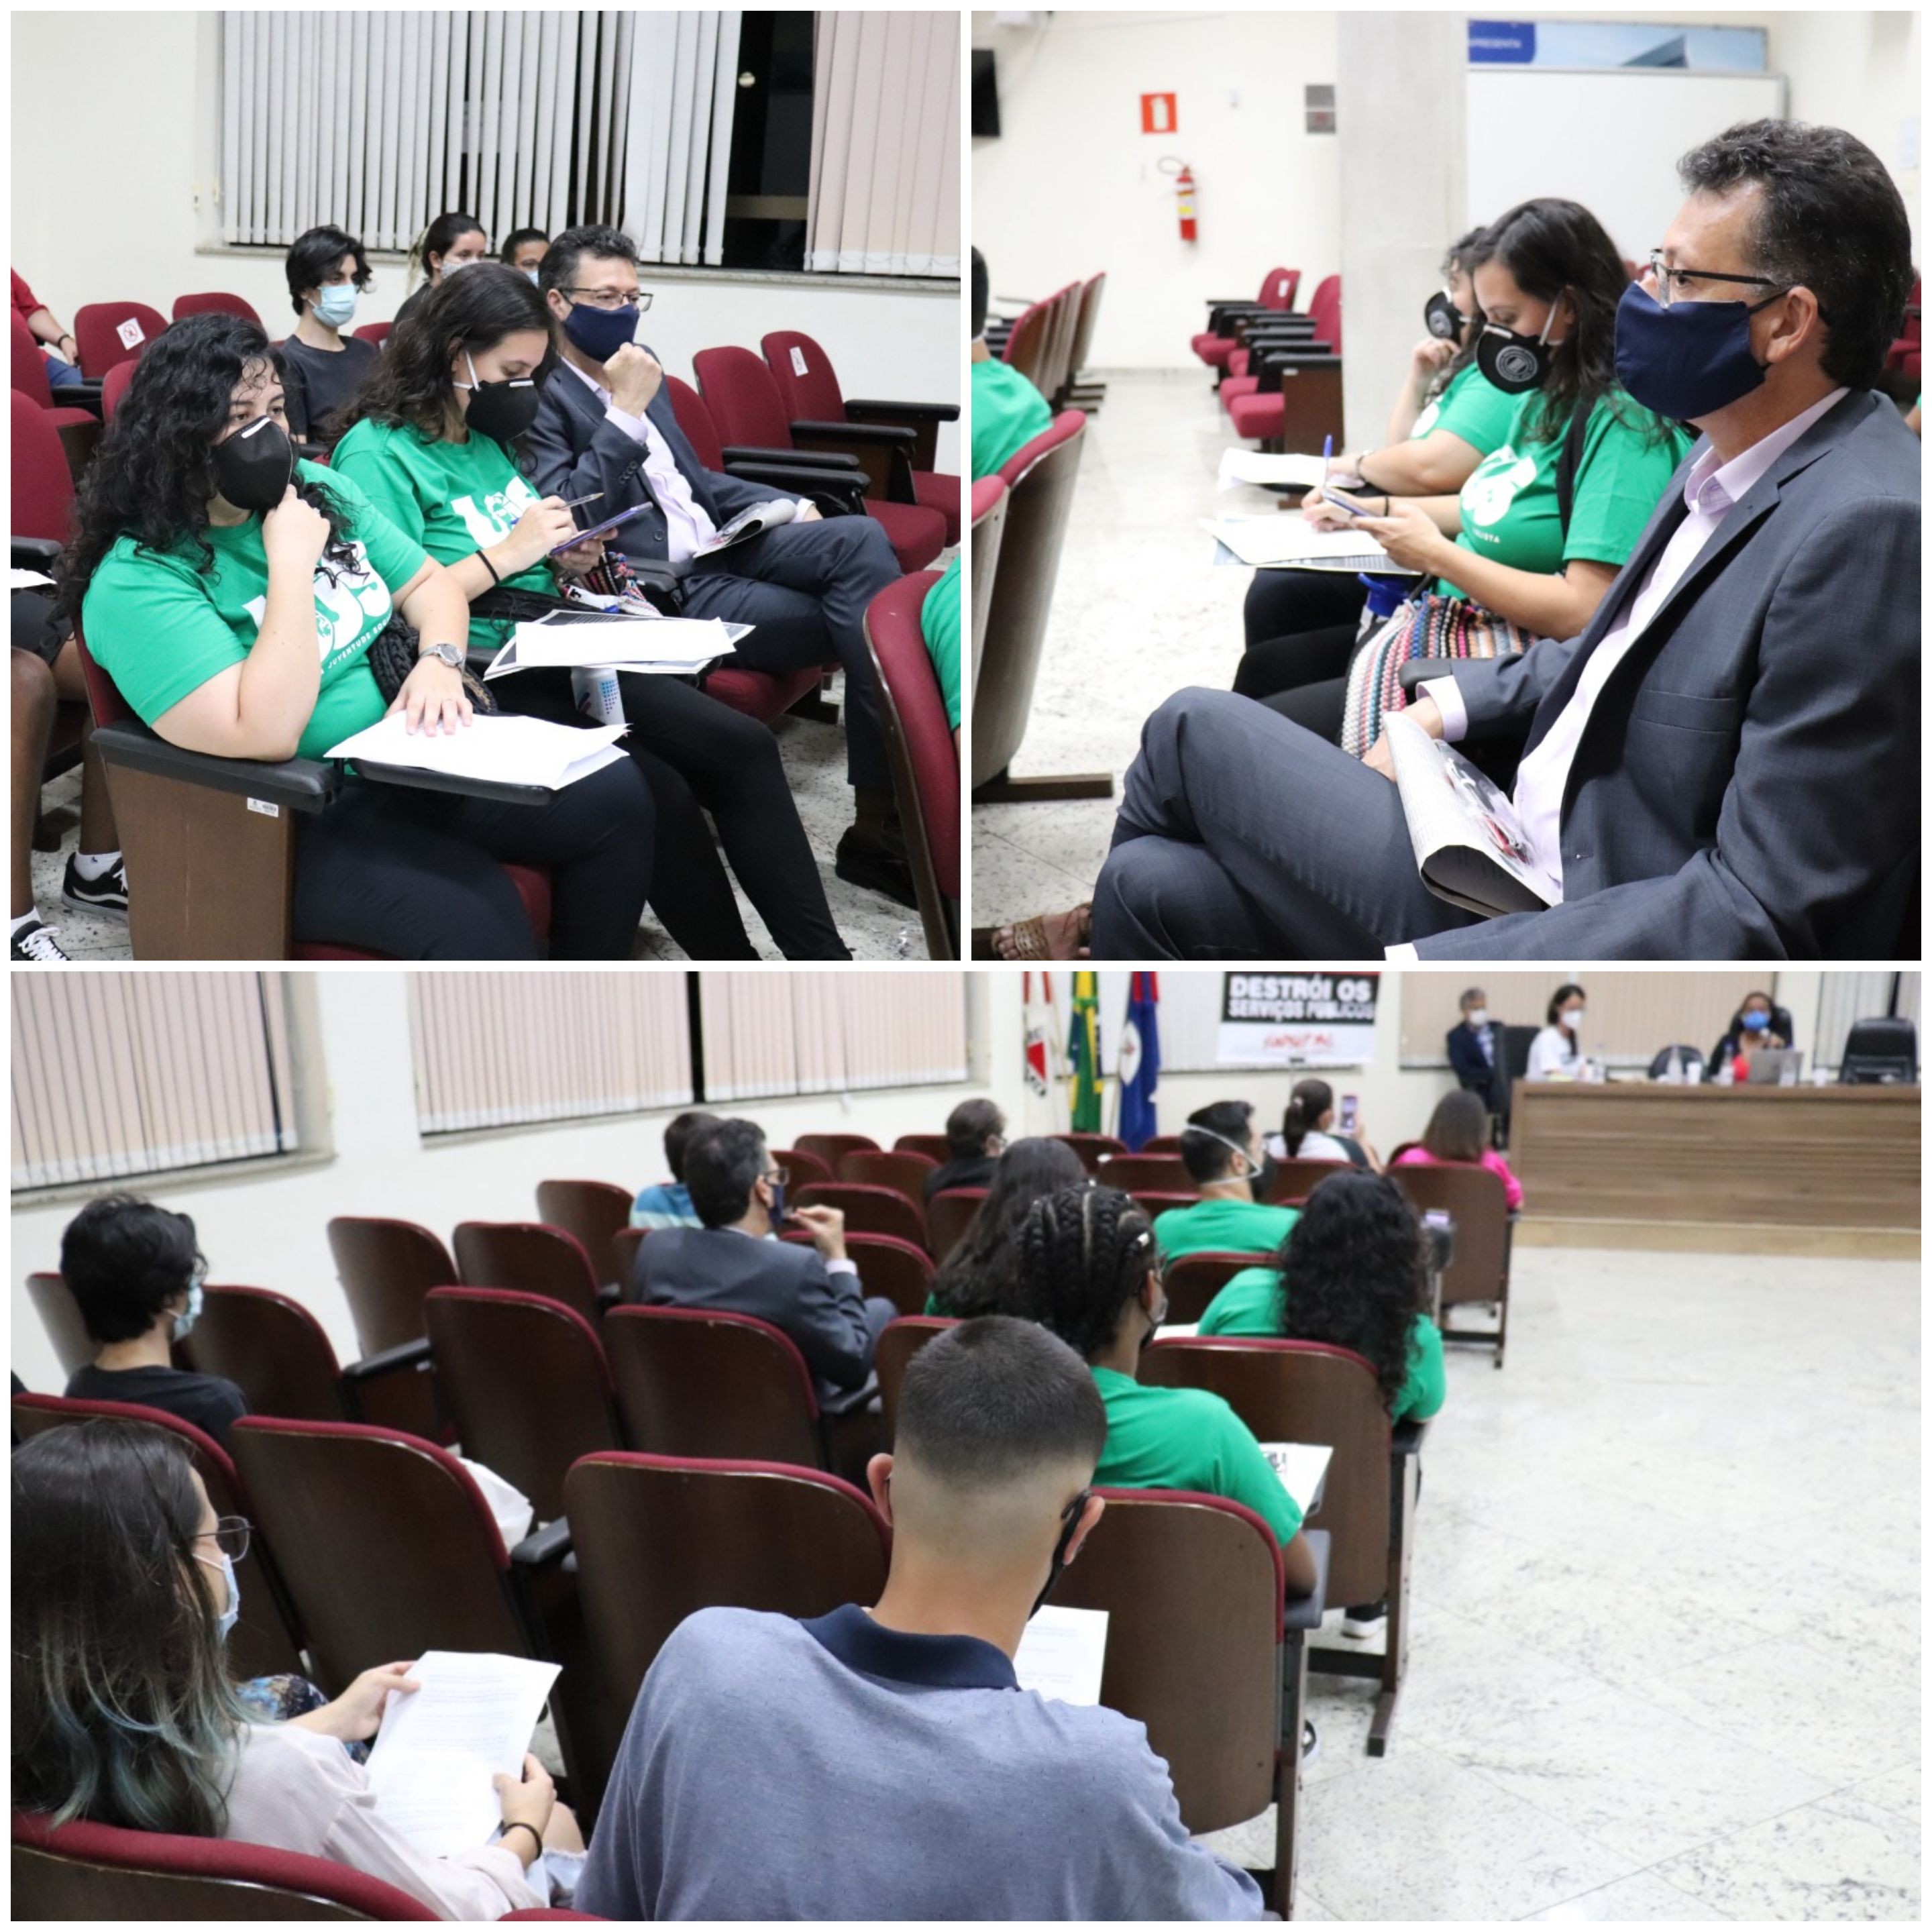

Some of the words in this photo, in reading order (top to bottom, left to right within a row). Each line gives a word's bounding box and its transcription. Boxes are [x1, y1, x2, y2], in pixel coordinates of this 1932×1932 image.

[328, 632, 371, 669] JUVENTUDE
[1229, 974, 1332, 1000] DESTRÓI
[1336, 979, 1372, 1003] OS
[1228, 999, 1304, 1022] SERVIÇOS
